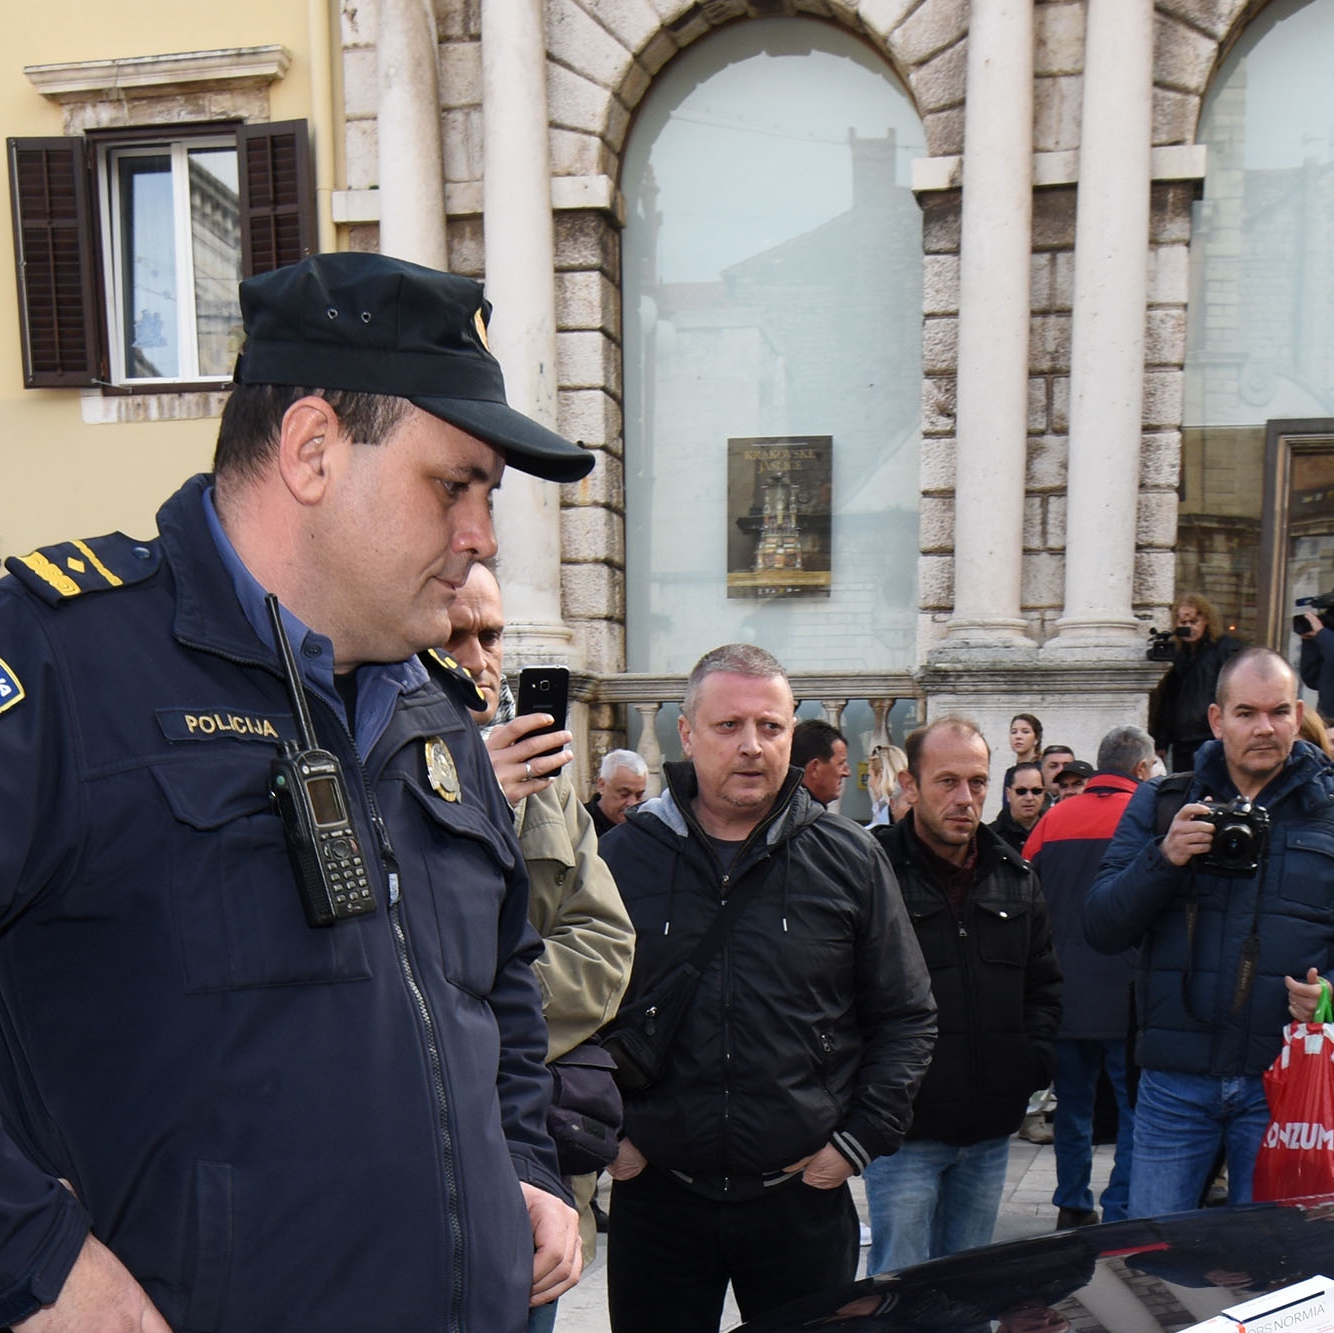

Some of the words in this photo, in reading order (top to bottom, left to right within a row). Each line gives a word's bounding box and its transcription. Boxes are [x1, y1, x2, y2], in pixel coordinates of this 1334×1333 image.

[184, 714, 279, 739] POLICIJA
[1263, 1121, 1334, 1151] ONZUM
[1273, 1303, 1326, 1329] NORMIA
